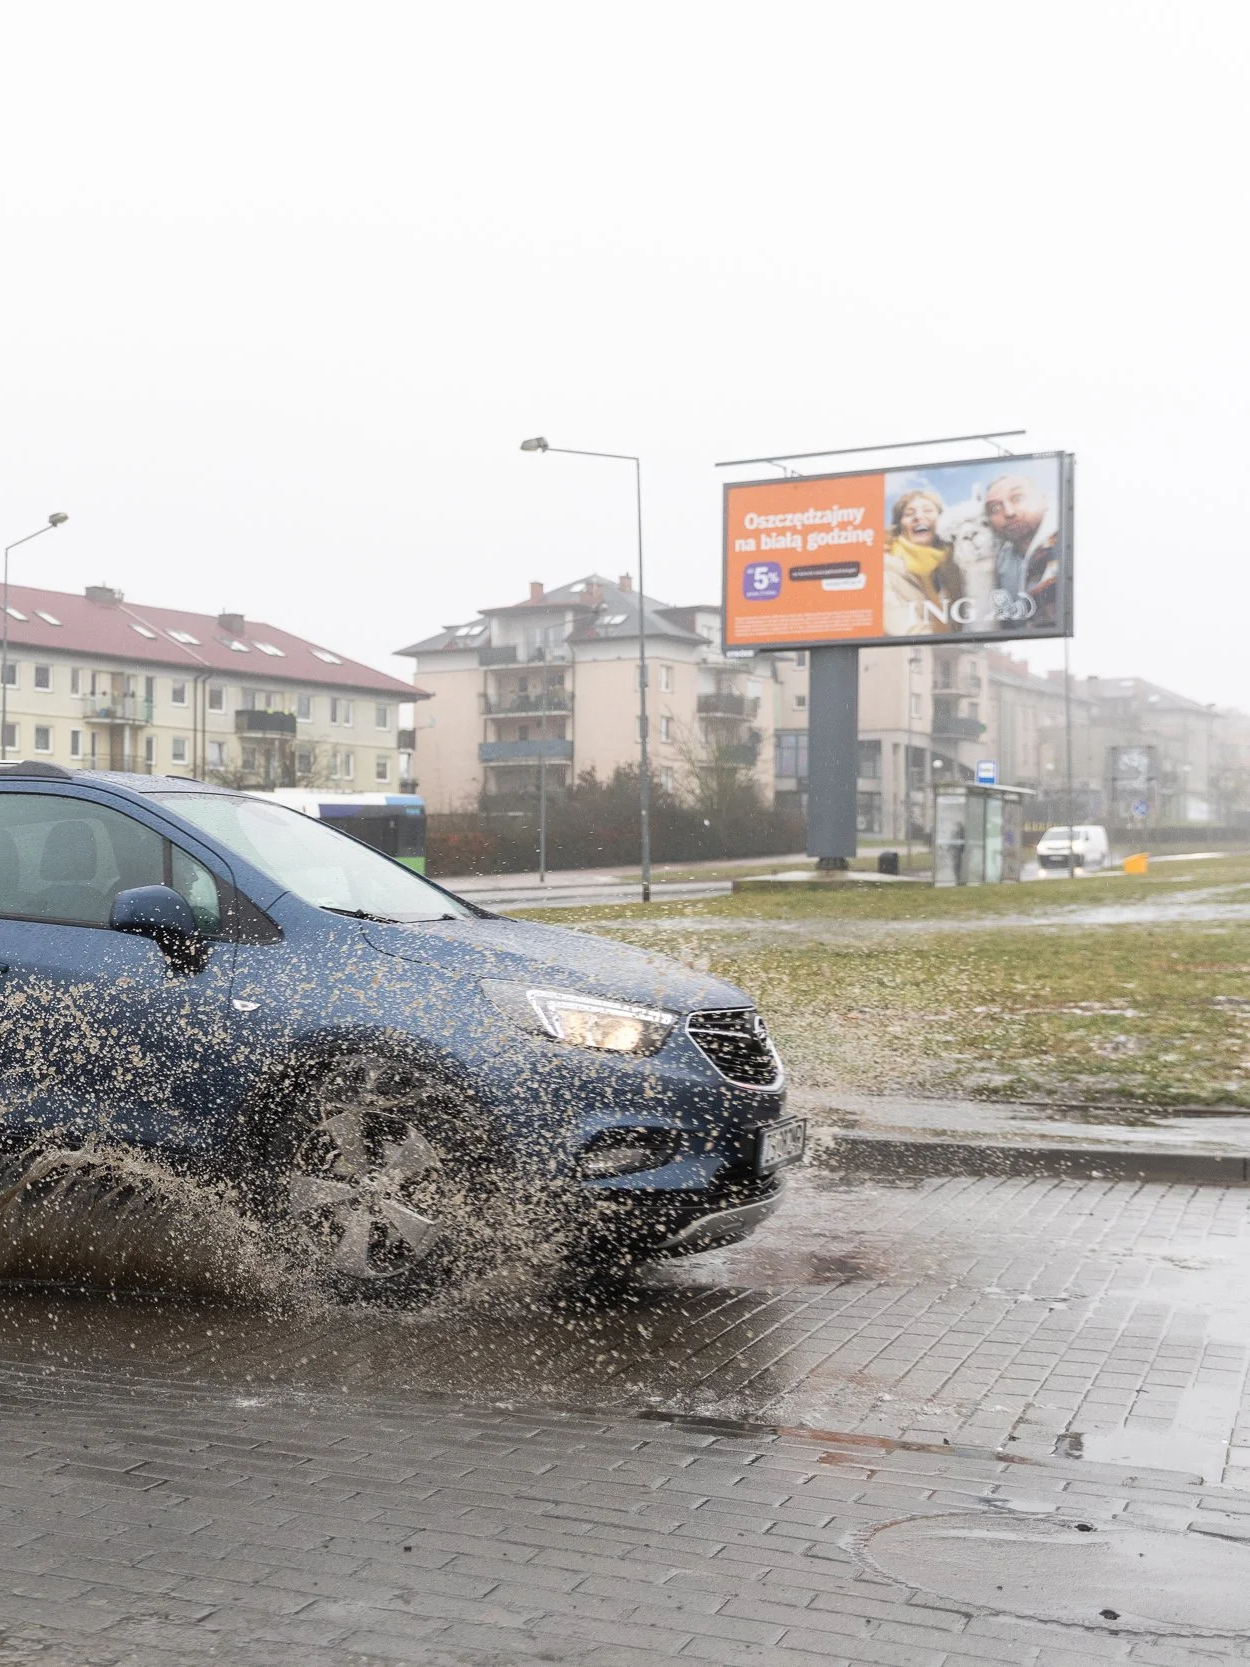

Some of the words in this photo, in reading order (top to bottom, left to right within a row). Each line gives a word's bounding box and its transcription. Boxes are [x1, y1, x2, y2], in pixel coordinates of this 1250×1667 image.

[744, 505, 865, 529] Oszczędzajmy
[735, 538, 756, 552] na
[760, 531, 803, 552] białą
[806, 526, 875, 551] godzinę
[908, 597, 976, 625] ING
